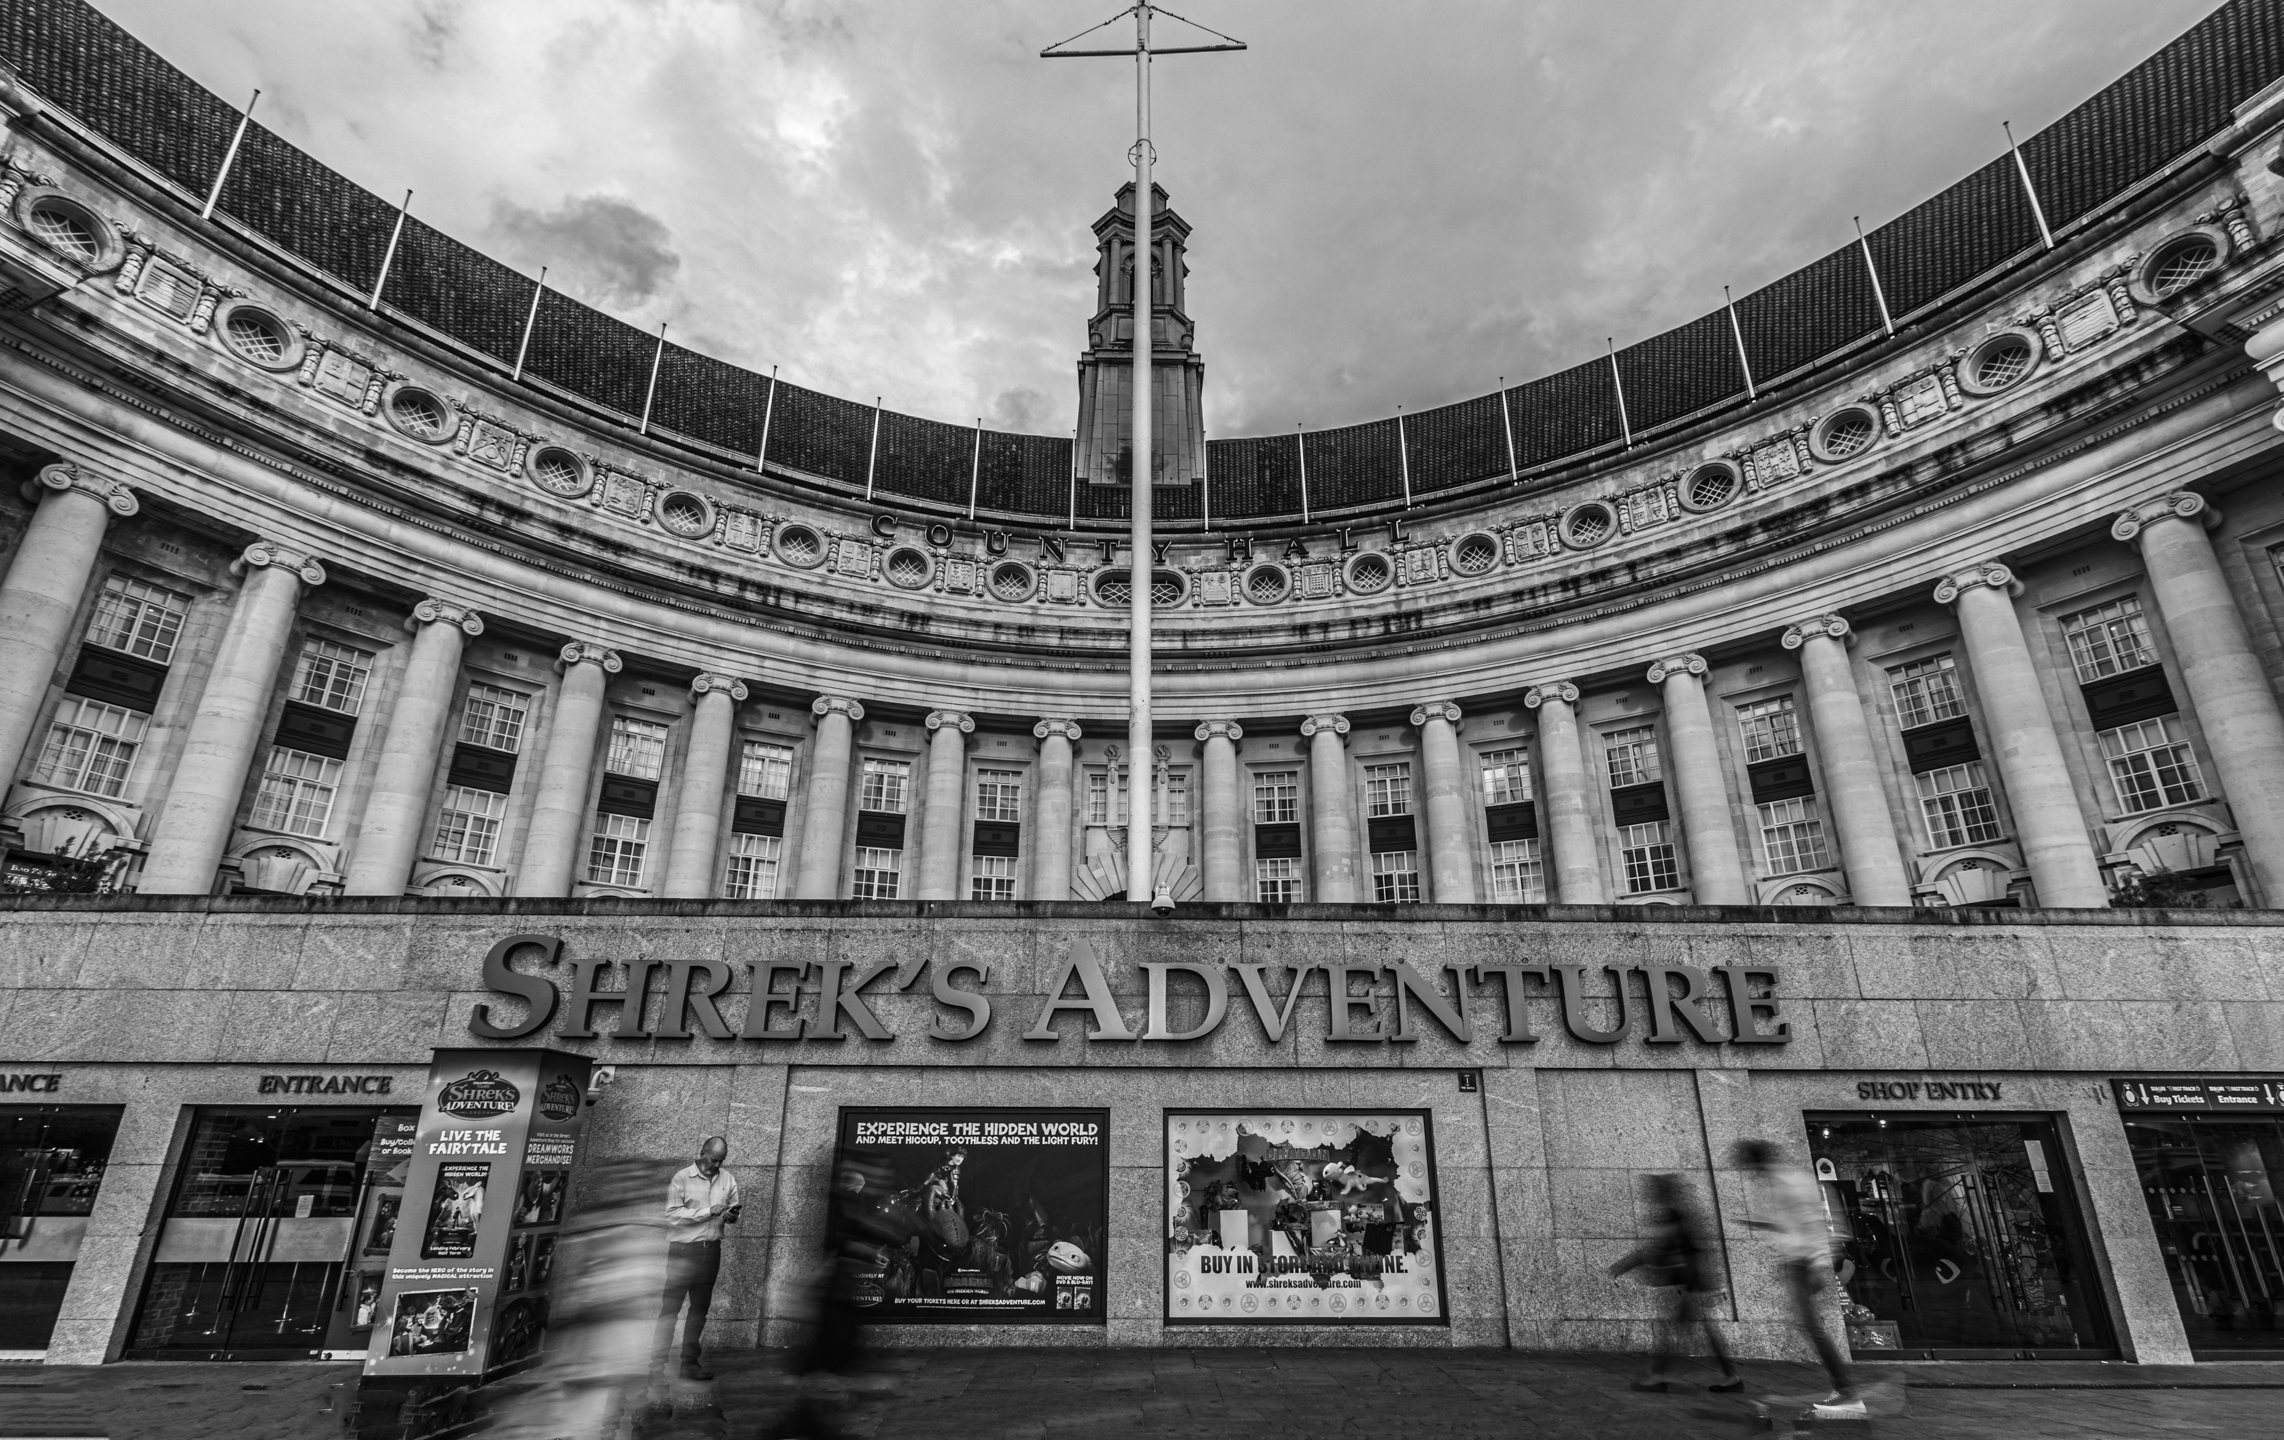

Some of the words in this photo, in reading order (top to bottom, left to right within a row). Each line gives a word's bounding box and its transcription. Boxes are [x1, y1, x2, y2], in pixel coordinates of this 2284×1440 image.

[870, 513, 1172, 563] COUNTY
[1224, 518, 1411, 562] HALL
[469, 933, 992, 1042] SHREK'S
[1023, 938, 1794, 1045] ADVENTURE
[257, 1075, 392, 1094] ENTRANCE
[1857, 1081, 1920, 1100] SHOP
[1924, 1081, 2002, 1100] ENTRY
[2153, 1095, 2172, 1105] Buy
[2172, 1095, 2205, 1103] Tickets
[2217, 1095, 2258, 1104] Entrance
[443, 1101, 516, 1111] ADVENTURE!
[397, 1123, 416, 1132] Box
[857, 1122, 949, 1136] EXPERIENCE
[953, 1122, 981, 1136] THE
[984, 1122, 1038, 1136] HIDDEN
[1041, 1122, 1099, 1136] WORLD
[440, 1130, 472, 1142] LIVE
[475, 1130, 501, 1142] THE
[856, 1136, 876, 1144] AND
[877, 1136, 904, 1144] MEET
[905, 1136, 941, 1145] HICCUP,
[944, 1136, 999, 1145] TOOTHLESS
[1000, 1136, 1021, 1145] AND
[1022, 1136, 1040, 1145] THE
[1042, 1136, 1070, 1145] LIGHT
[1071, 1136, 1099, 1145] FURY!
[428, 1143, 508, 1155] FAIRYTALE
[527, 1143, 575, 1155] DREAMWORKS
[525, 1154, 572, 1165] MERCHANDISE!
[1200, 1255, 1233, 1274] BUY
[1236, 1255, 1253, 1274] IN
[1257, 1255, 1309, 1274] STORE
[1246, 1278, 1362, 1289] www.shreksadveure.com
